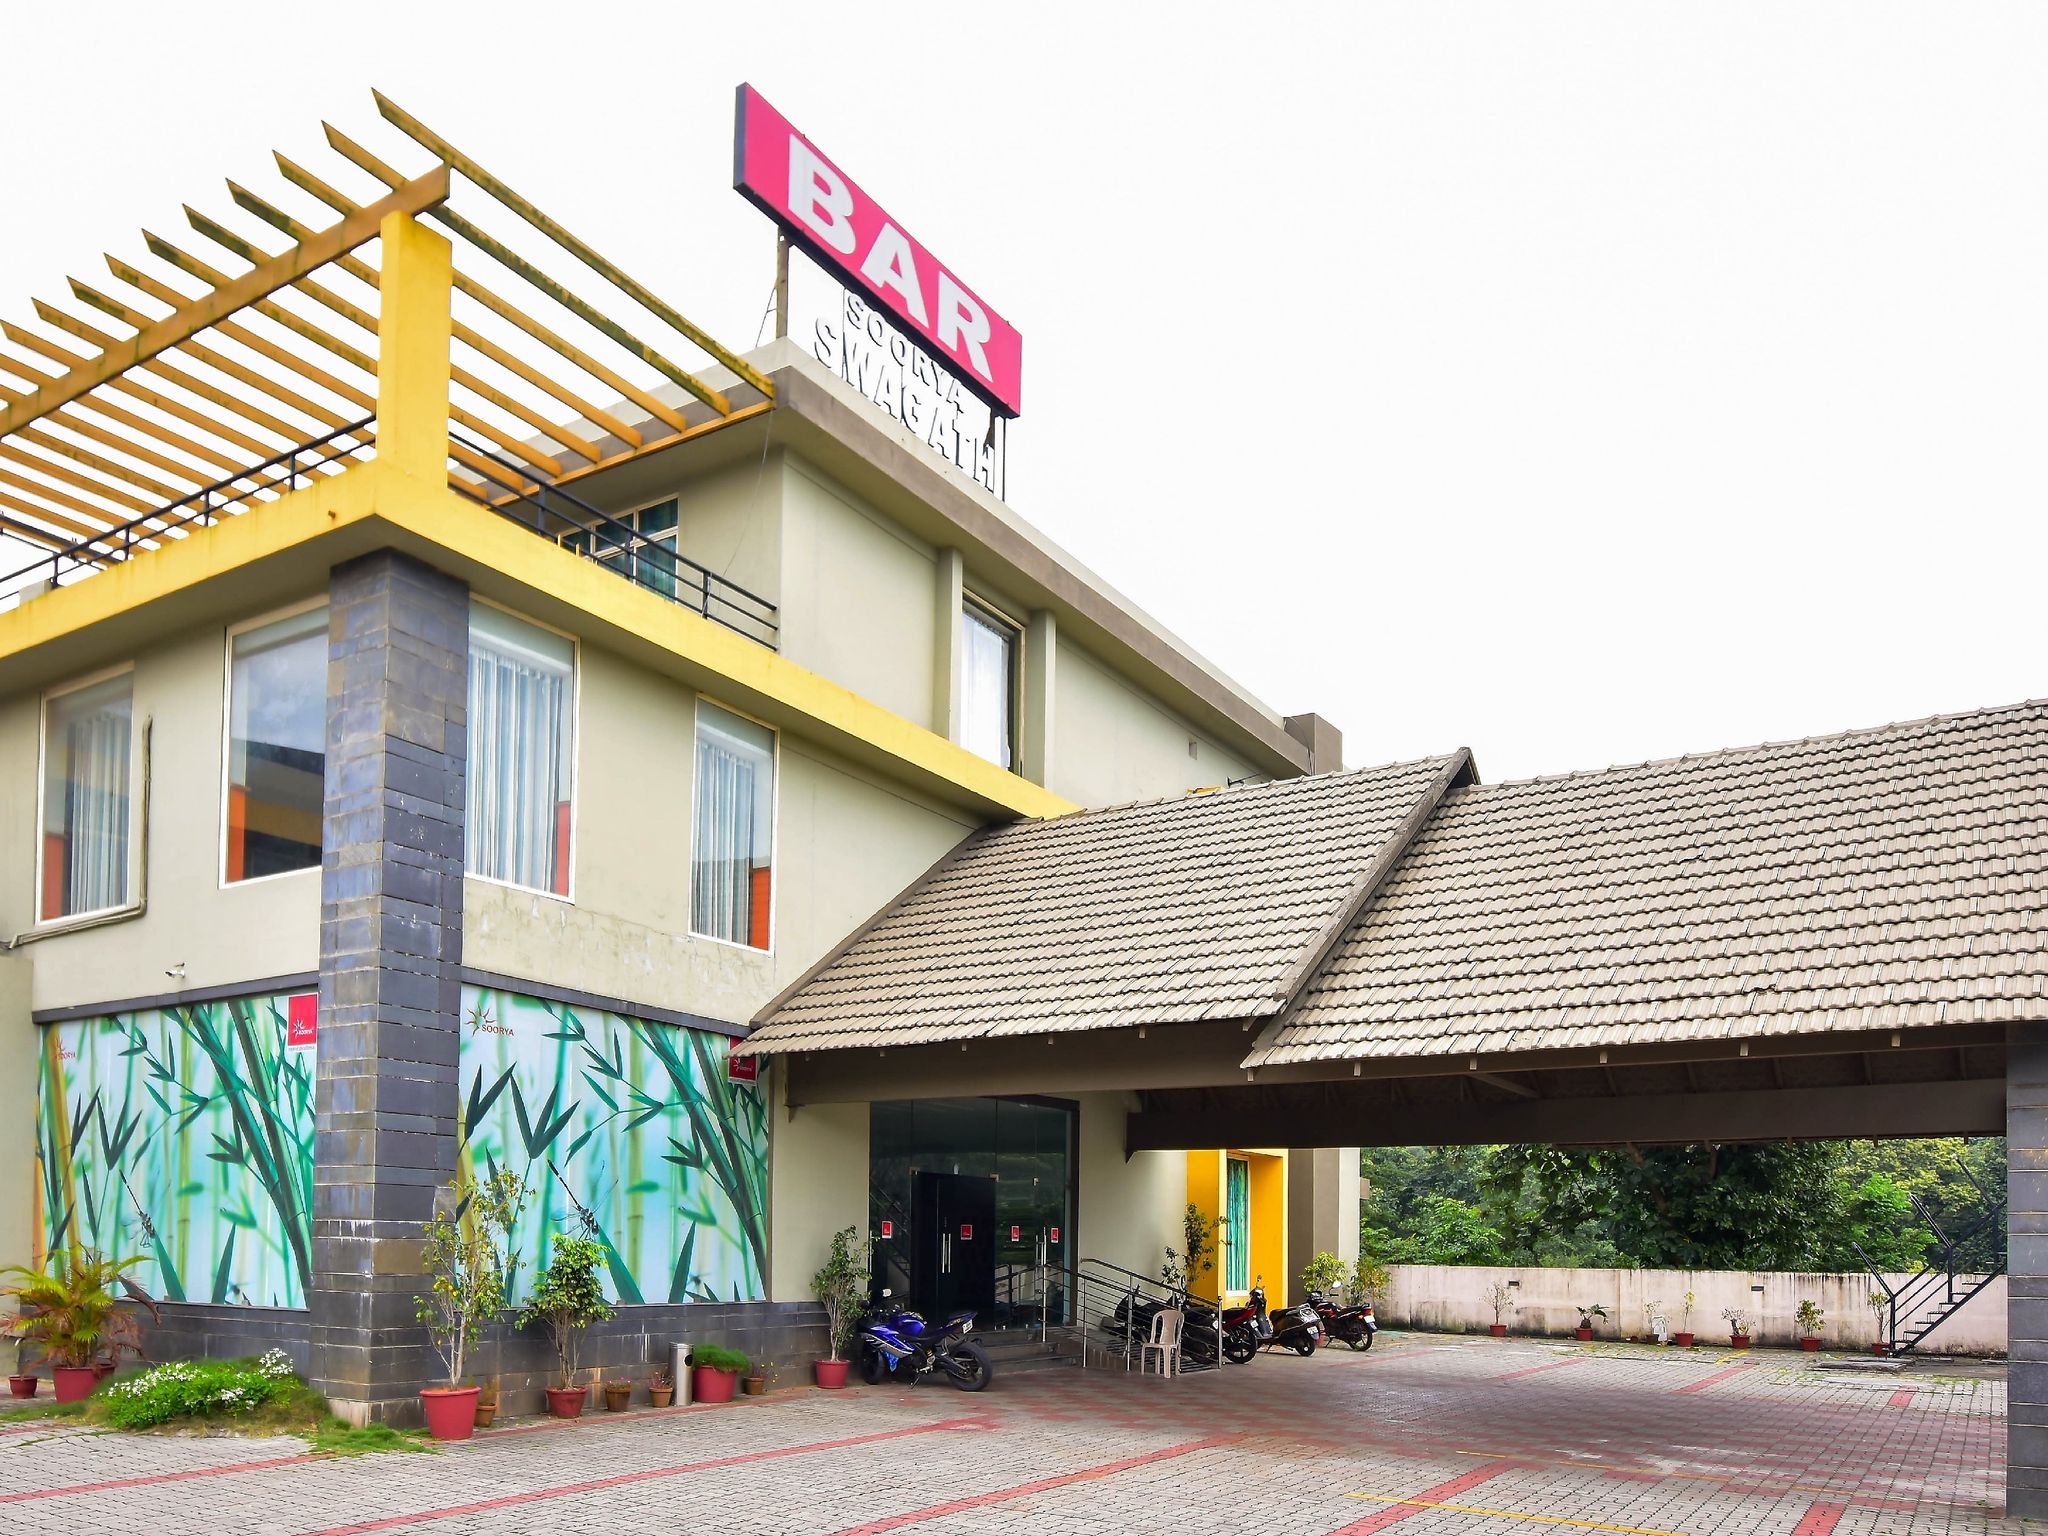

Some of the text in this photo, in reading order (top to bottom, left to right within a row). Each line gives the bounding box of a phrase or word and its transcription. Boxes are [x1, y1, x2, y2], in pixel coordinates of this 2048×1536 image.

[788, 133, 993, 383] BAR
[814, 317, 995, 494] SWAGATH
[847, 292, 964, 414] SOORYA
[481, 1024, 514, 1036] SOORYA
